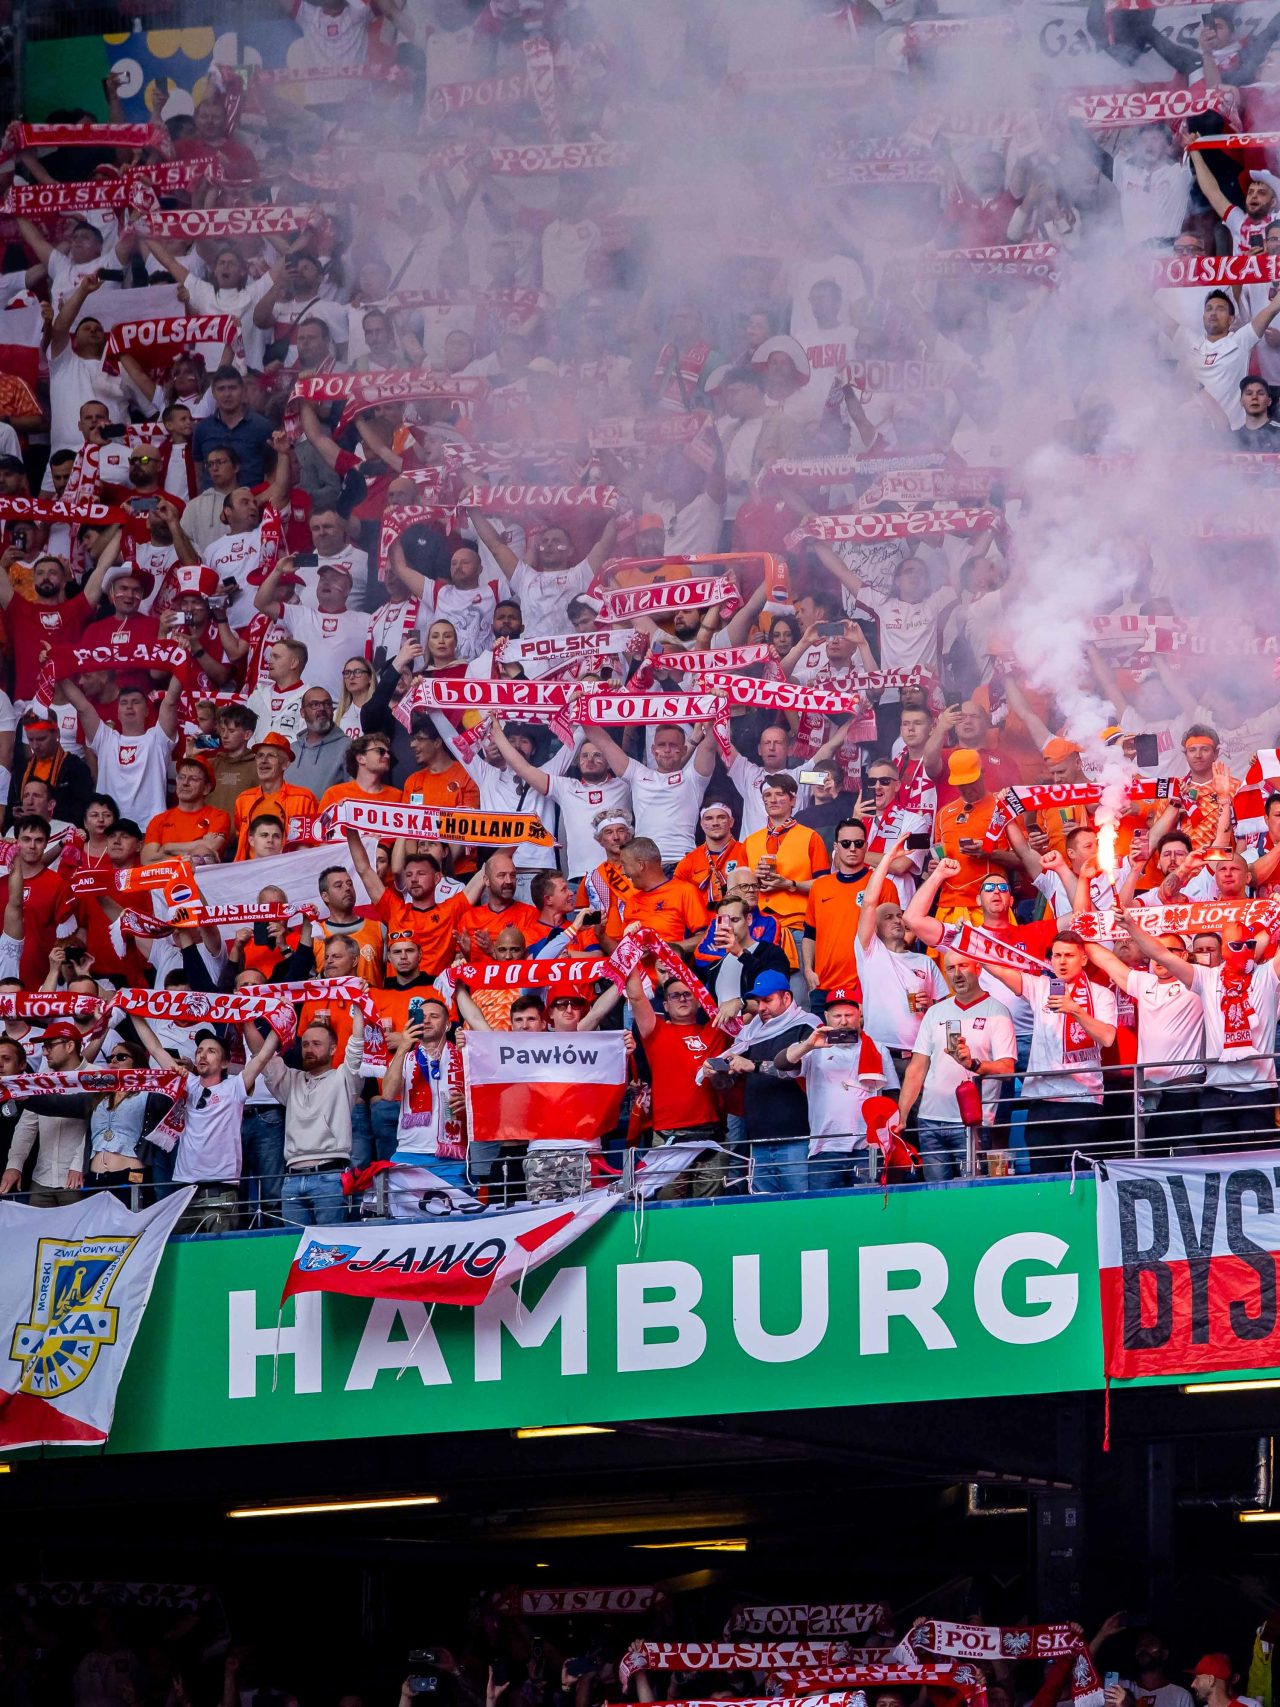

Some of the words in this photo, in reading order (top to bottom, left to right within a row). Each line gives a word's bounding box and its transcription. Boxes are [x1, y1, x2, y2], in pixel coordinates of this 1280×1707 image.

[1080, 87, 1222, 121] POLSKA
[19, 187, 127, 208] POLSKA
[160, 207, 299, 237] POLSKA
[121, 316, 221, 343] POLSKA
[73, 647, 187, 668] POLAND
[520, 637, 611, 659] POLSKA
[596, 692, 720, 718] POLSKA
[717, 673, 848, 713] POLSKA
[353, 808, 434, 832] POLSKA
[442, 817, 526, 838] HOLLAND
[482, 961, 606, 986] POLSKA
[499, 1044, 600, 1066] Pawłów
[38, 1262, 53, 1312] MORSKI
[228, 1231, 1080, 1400] HAMBURG
[657, 1641, 818, 1669] POLSKA
[944, 1632, 997, 1652] POL
